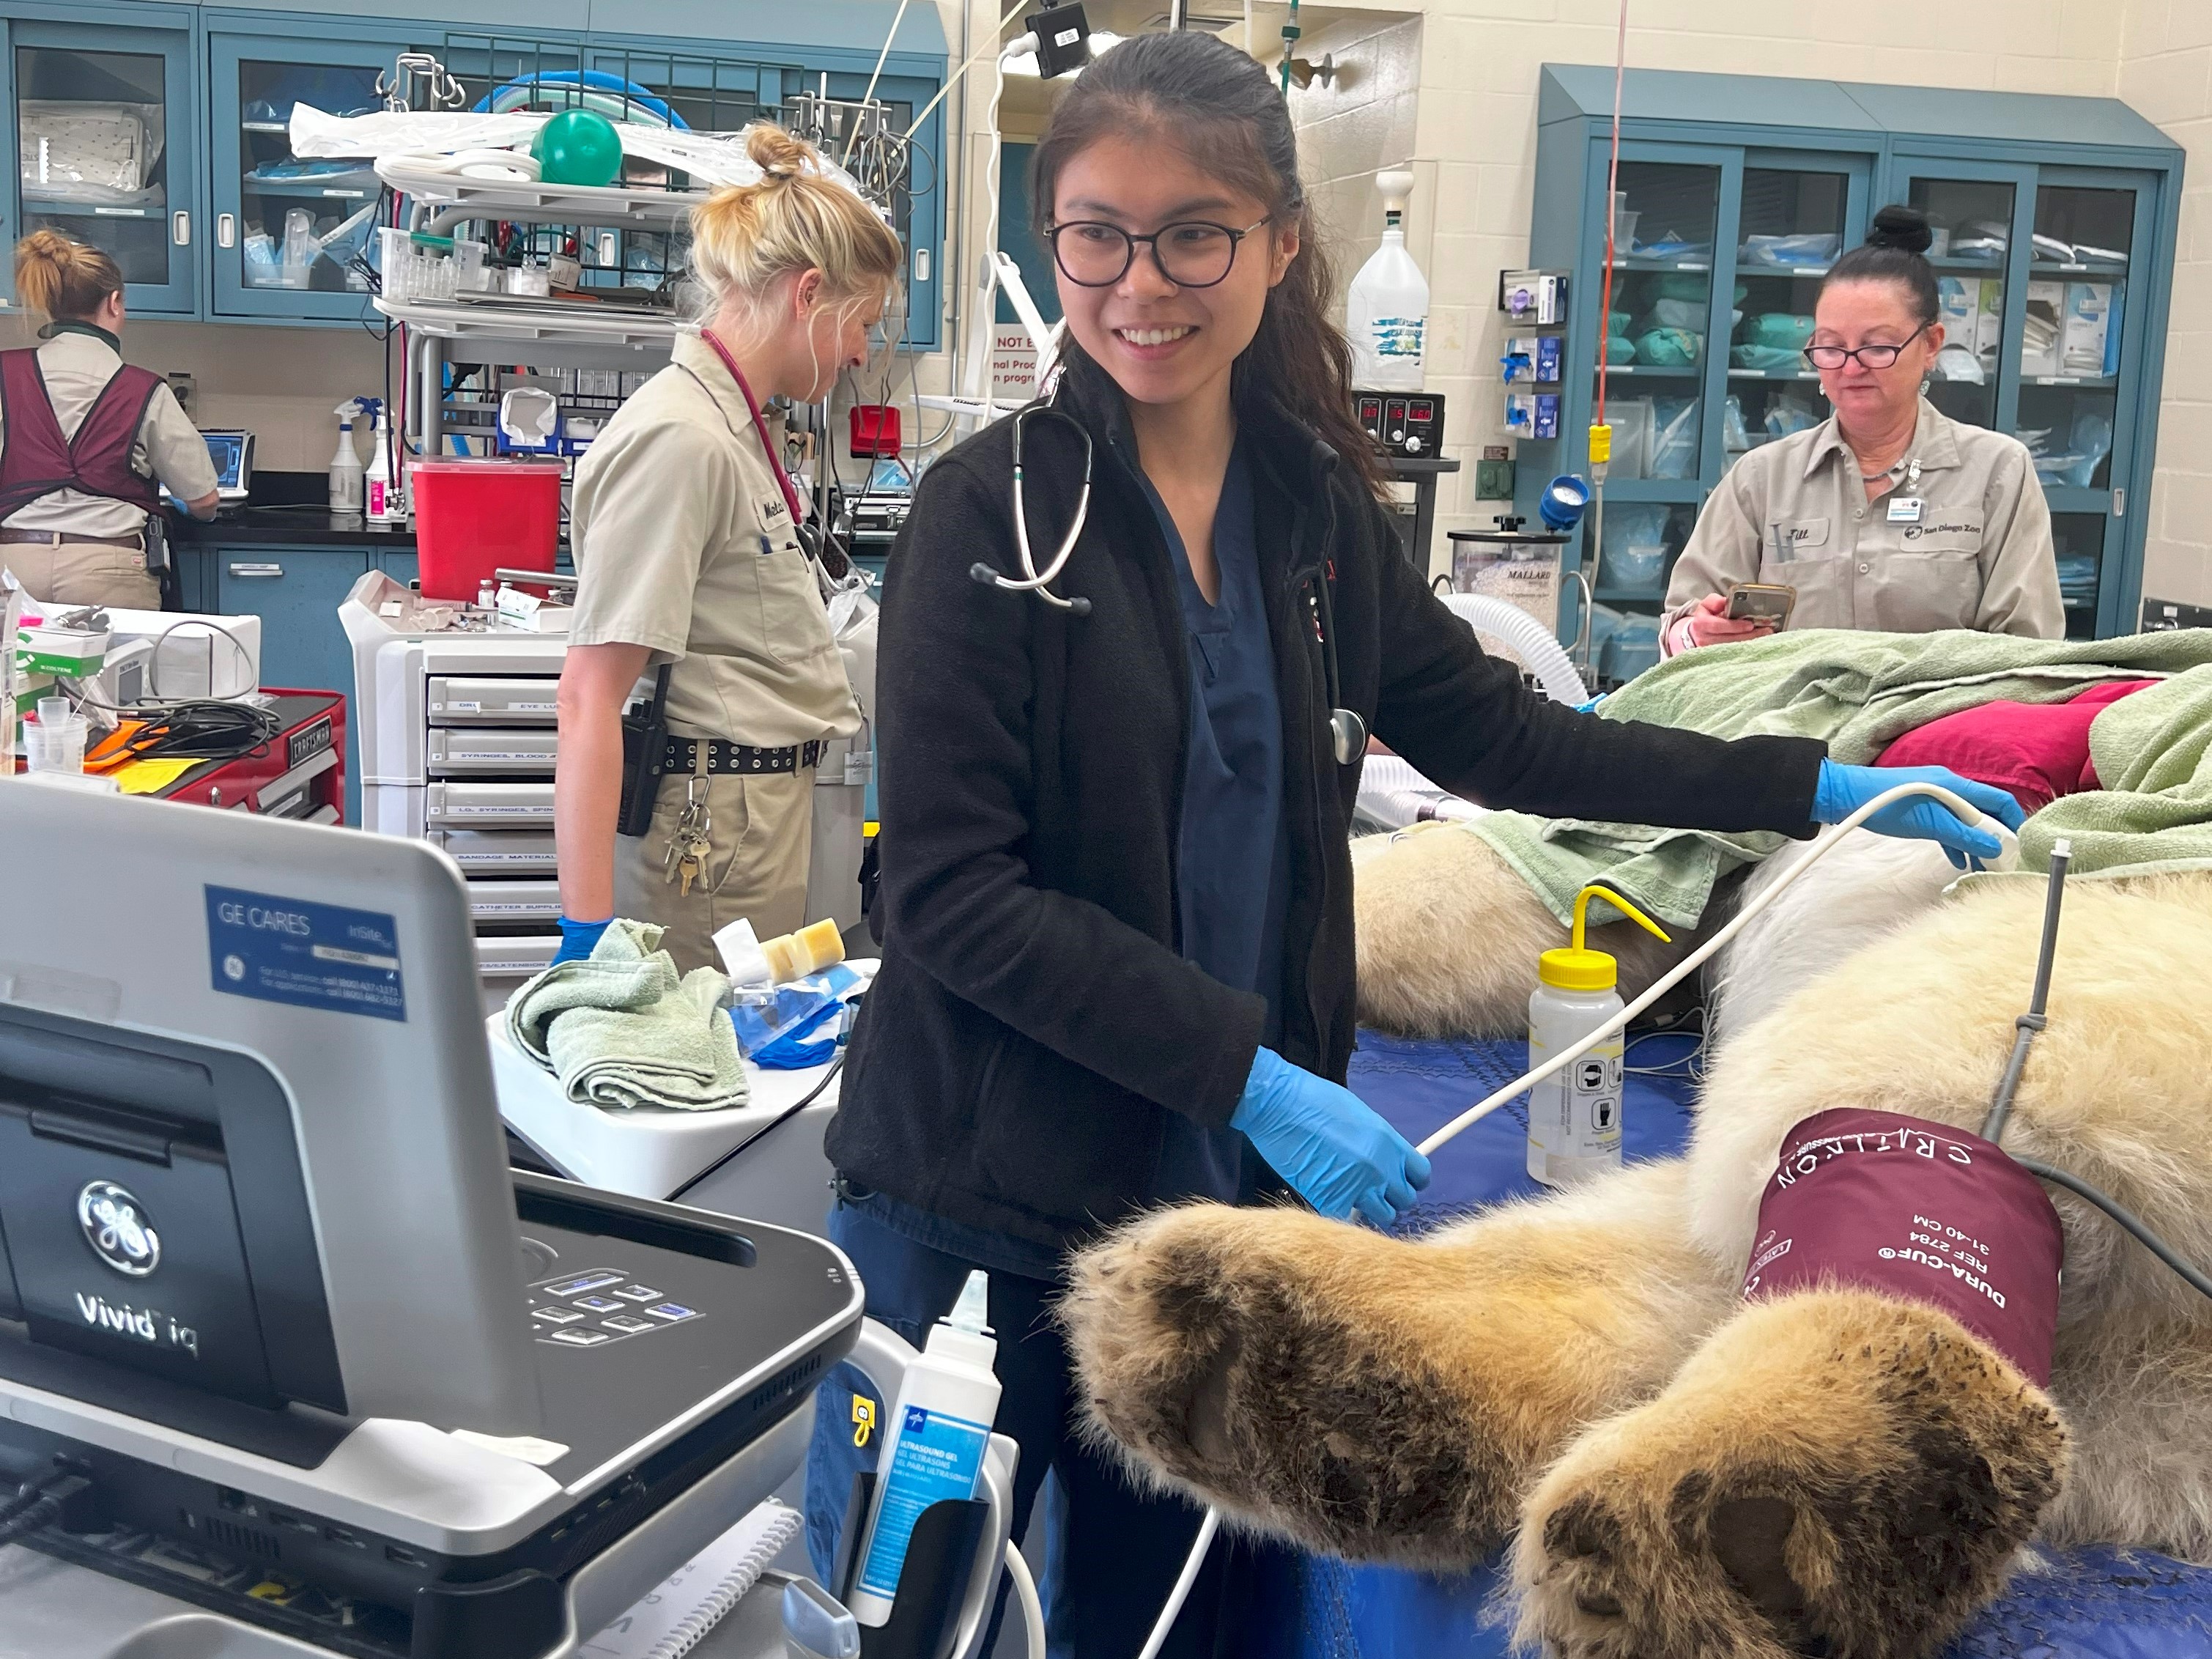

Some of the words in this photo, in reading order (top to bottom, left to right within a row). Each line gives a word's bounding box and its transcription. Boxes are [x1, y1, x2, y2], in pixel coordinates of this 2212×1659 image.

[997, 337, 1022, 347] NOT
[1923, 527, 1937, 535] San
[1964, 525, 1980, 533] Zoo
[1507, 570, 1551, 580] MALLARD
[293, 724, 330, 760] CRAFTSMAN
[218, 902, 245, 925] GE
[248, 907, 311, 936] CARES
[1777, 1128, 1972, 1189] CRITIKON
[1913, 1214, 1942, 1231] CM
[1909, 1231, 1950, 1252] 2784
[1945, 1226, 1990, 1256] 31-40
[1953, 1250, 1988, 1274] REF
[75, 1292, 157, 1341] Vivid
[900, 1440, 945, 1458] ULTRASOUND
[945, 1452, 958, 1463] GEL
[906, 1461, 925, 1473] PARA
